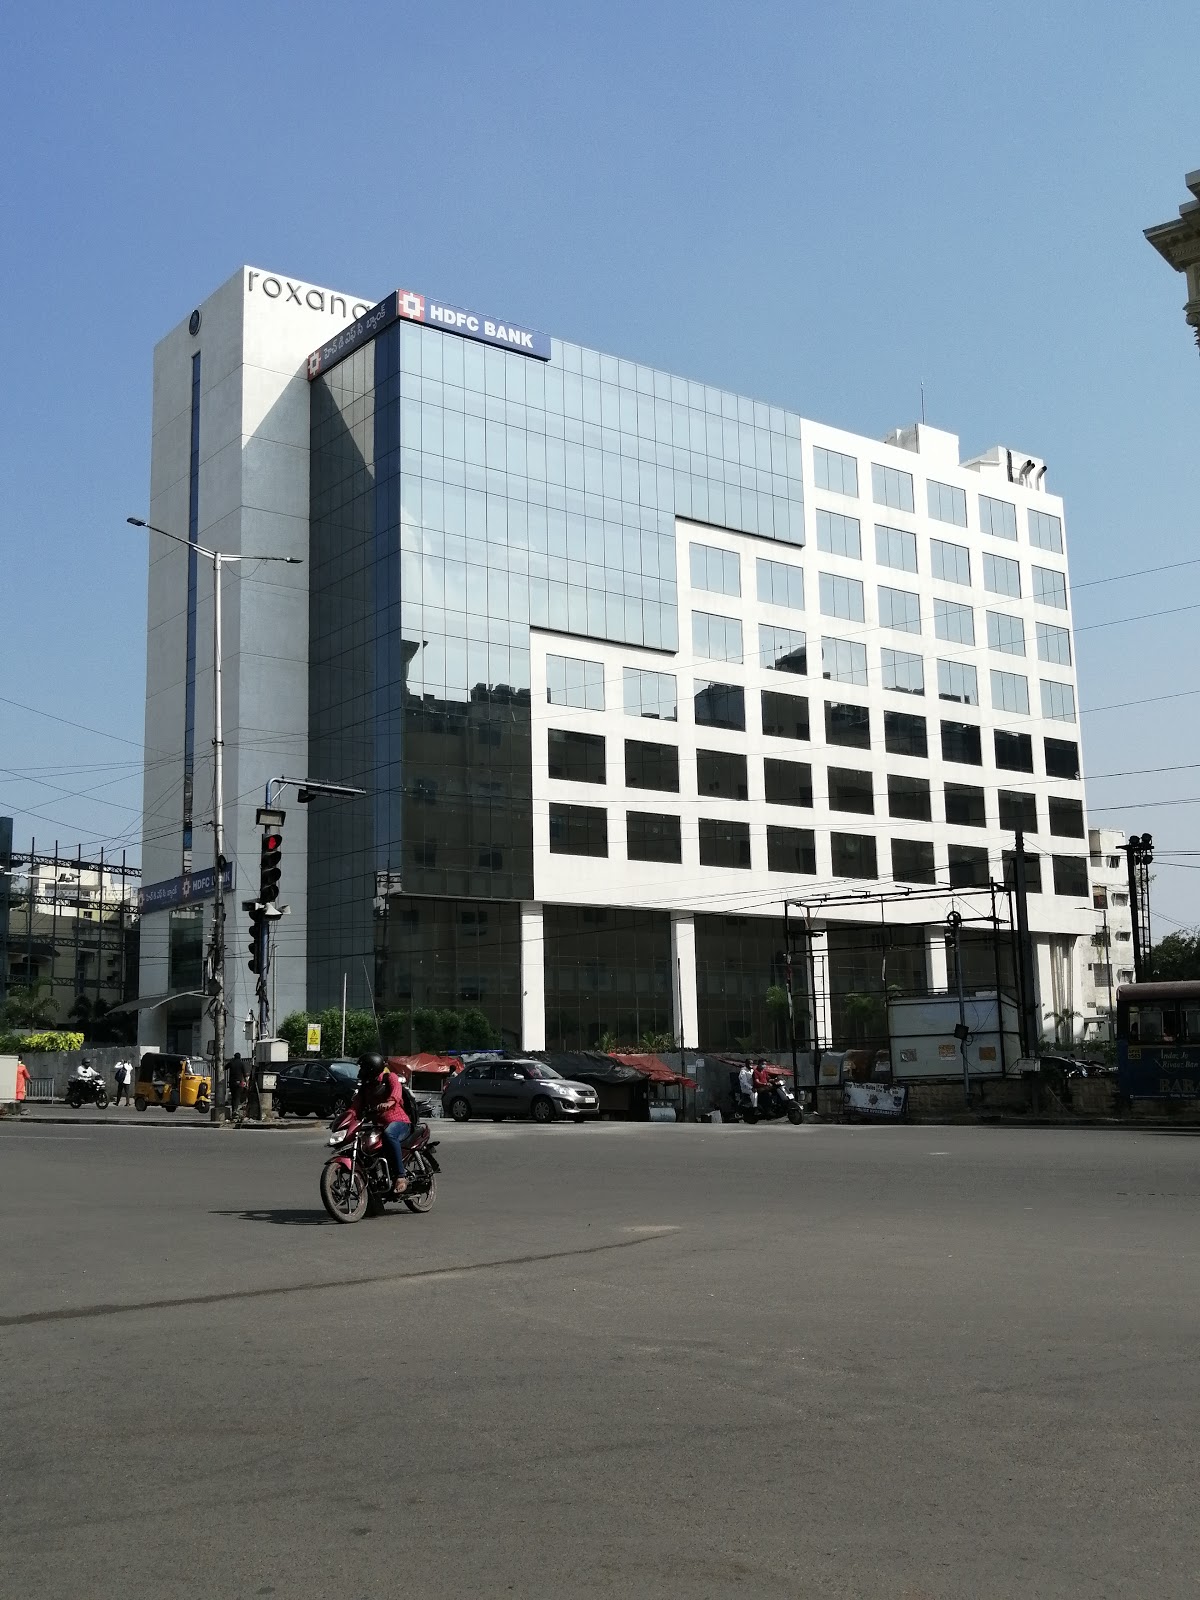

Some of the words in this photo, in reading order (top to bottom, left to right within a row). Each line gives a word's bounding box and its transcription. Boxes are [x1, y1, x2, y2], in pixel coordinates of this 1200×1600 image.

[430, 304, 479, 332] HDFC
[484, 320, 534, 349] BANK
[192, 876, 210, 891] HDFC
